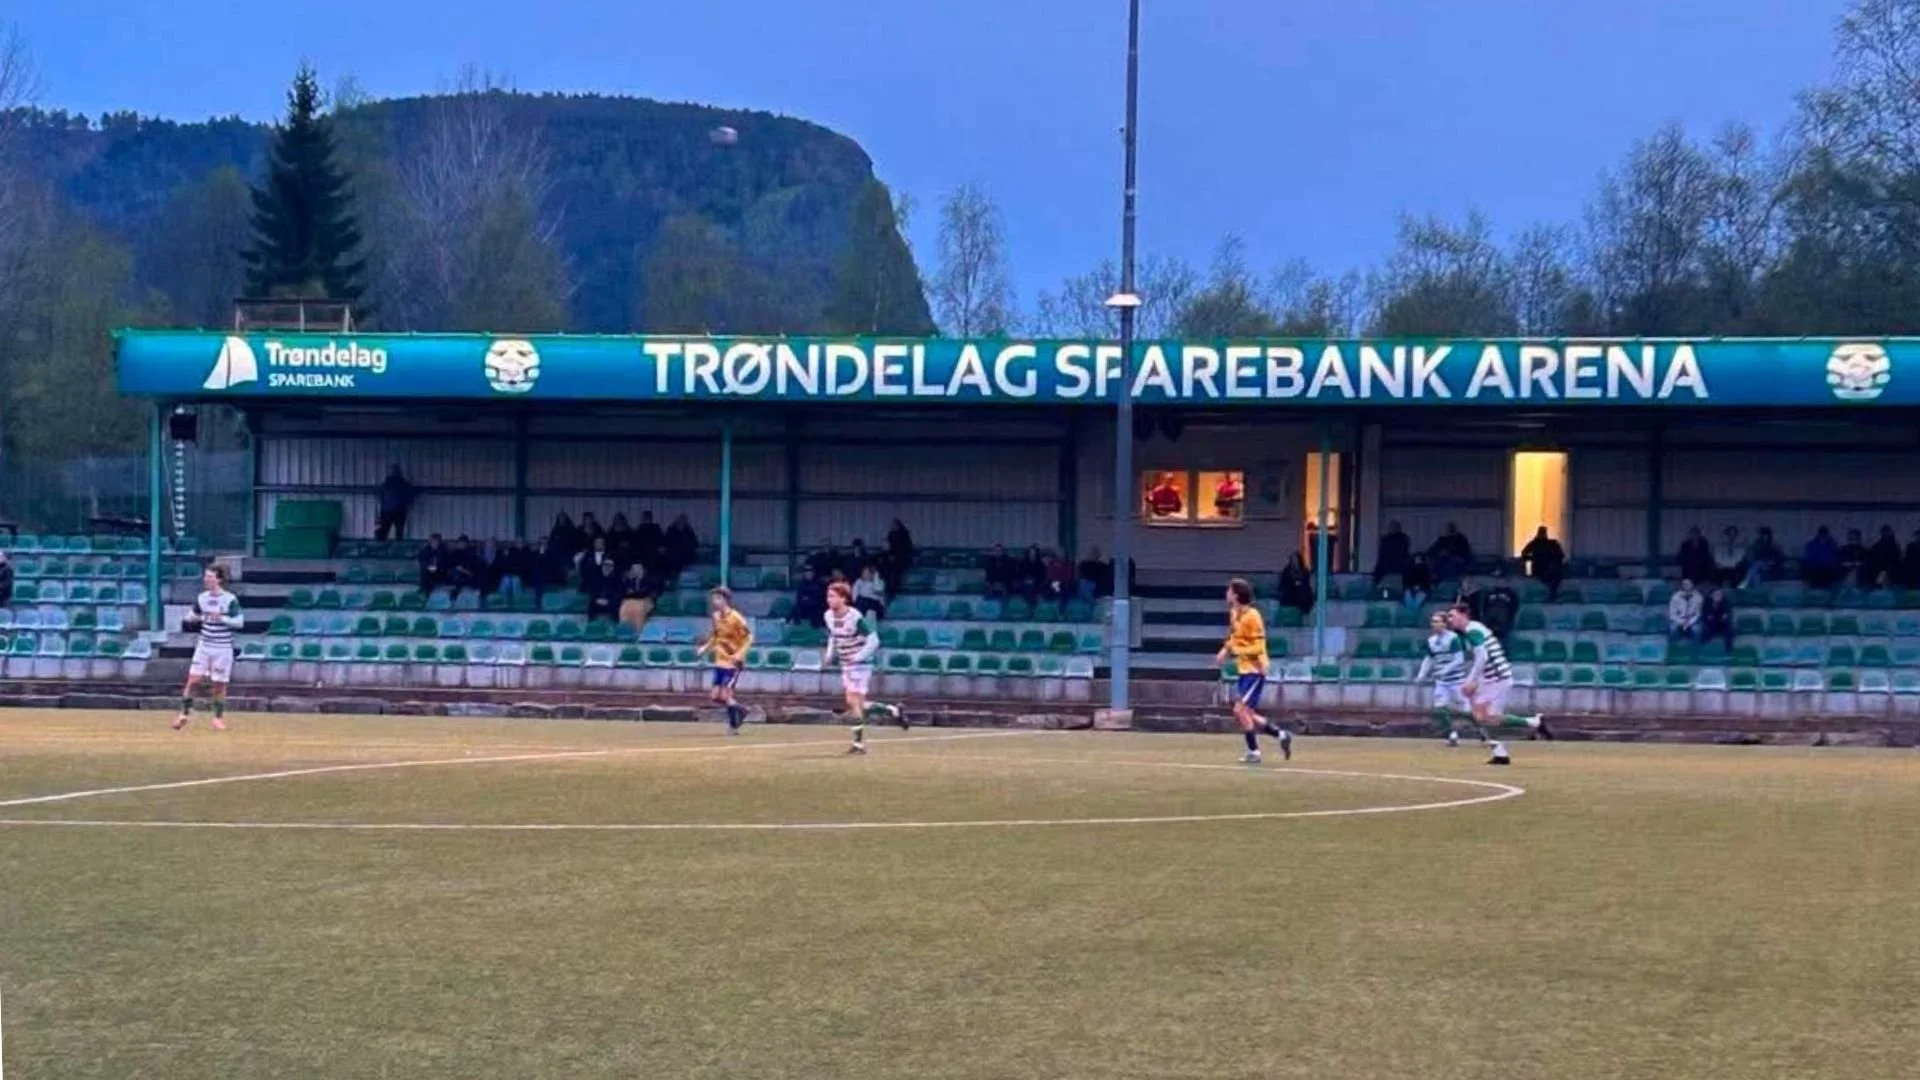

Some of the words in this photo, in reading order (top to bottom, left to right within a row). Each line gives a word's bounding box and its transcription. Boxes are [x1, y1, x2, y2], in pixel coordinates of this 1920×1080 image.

[264, 341, 388, 373] Trøndelag
[643, 343, 1038, 397] TRØNDELAG
[1056, 345, 1453, 398] SPAREBANK
[1466, 345, 1709, 399] ARENA
[268, 373, 355, 388] SPAREBANK
